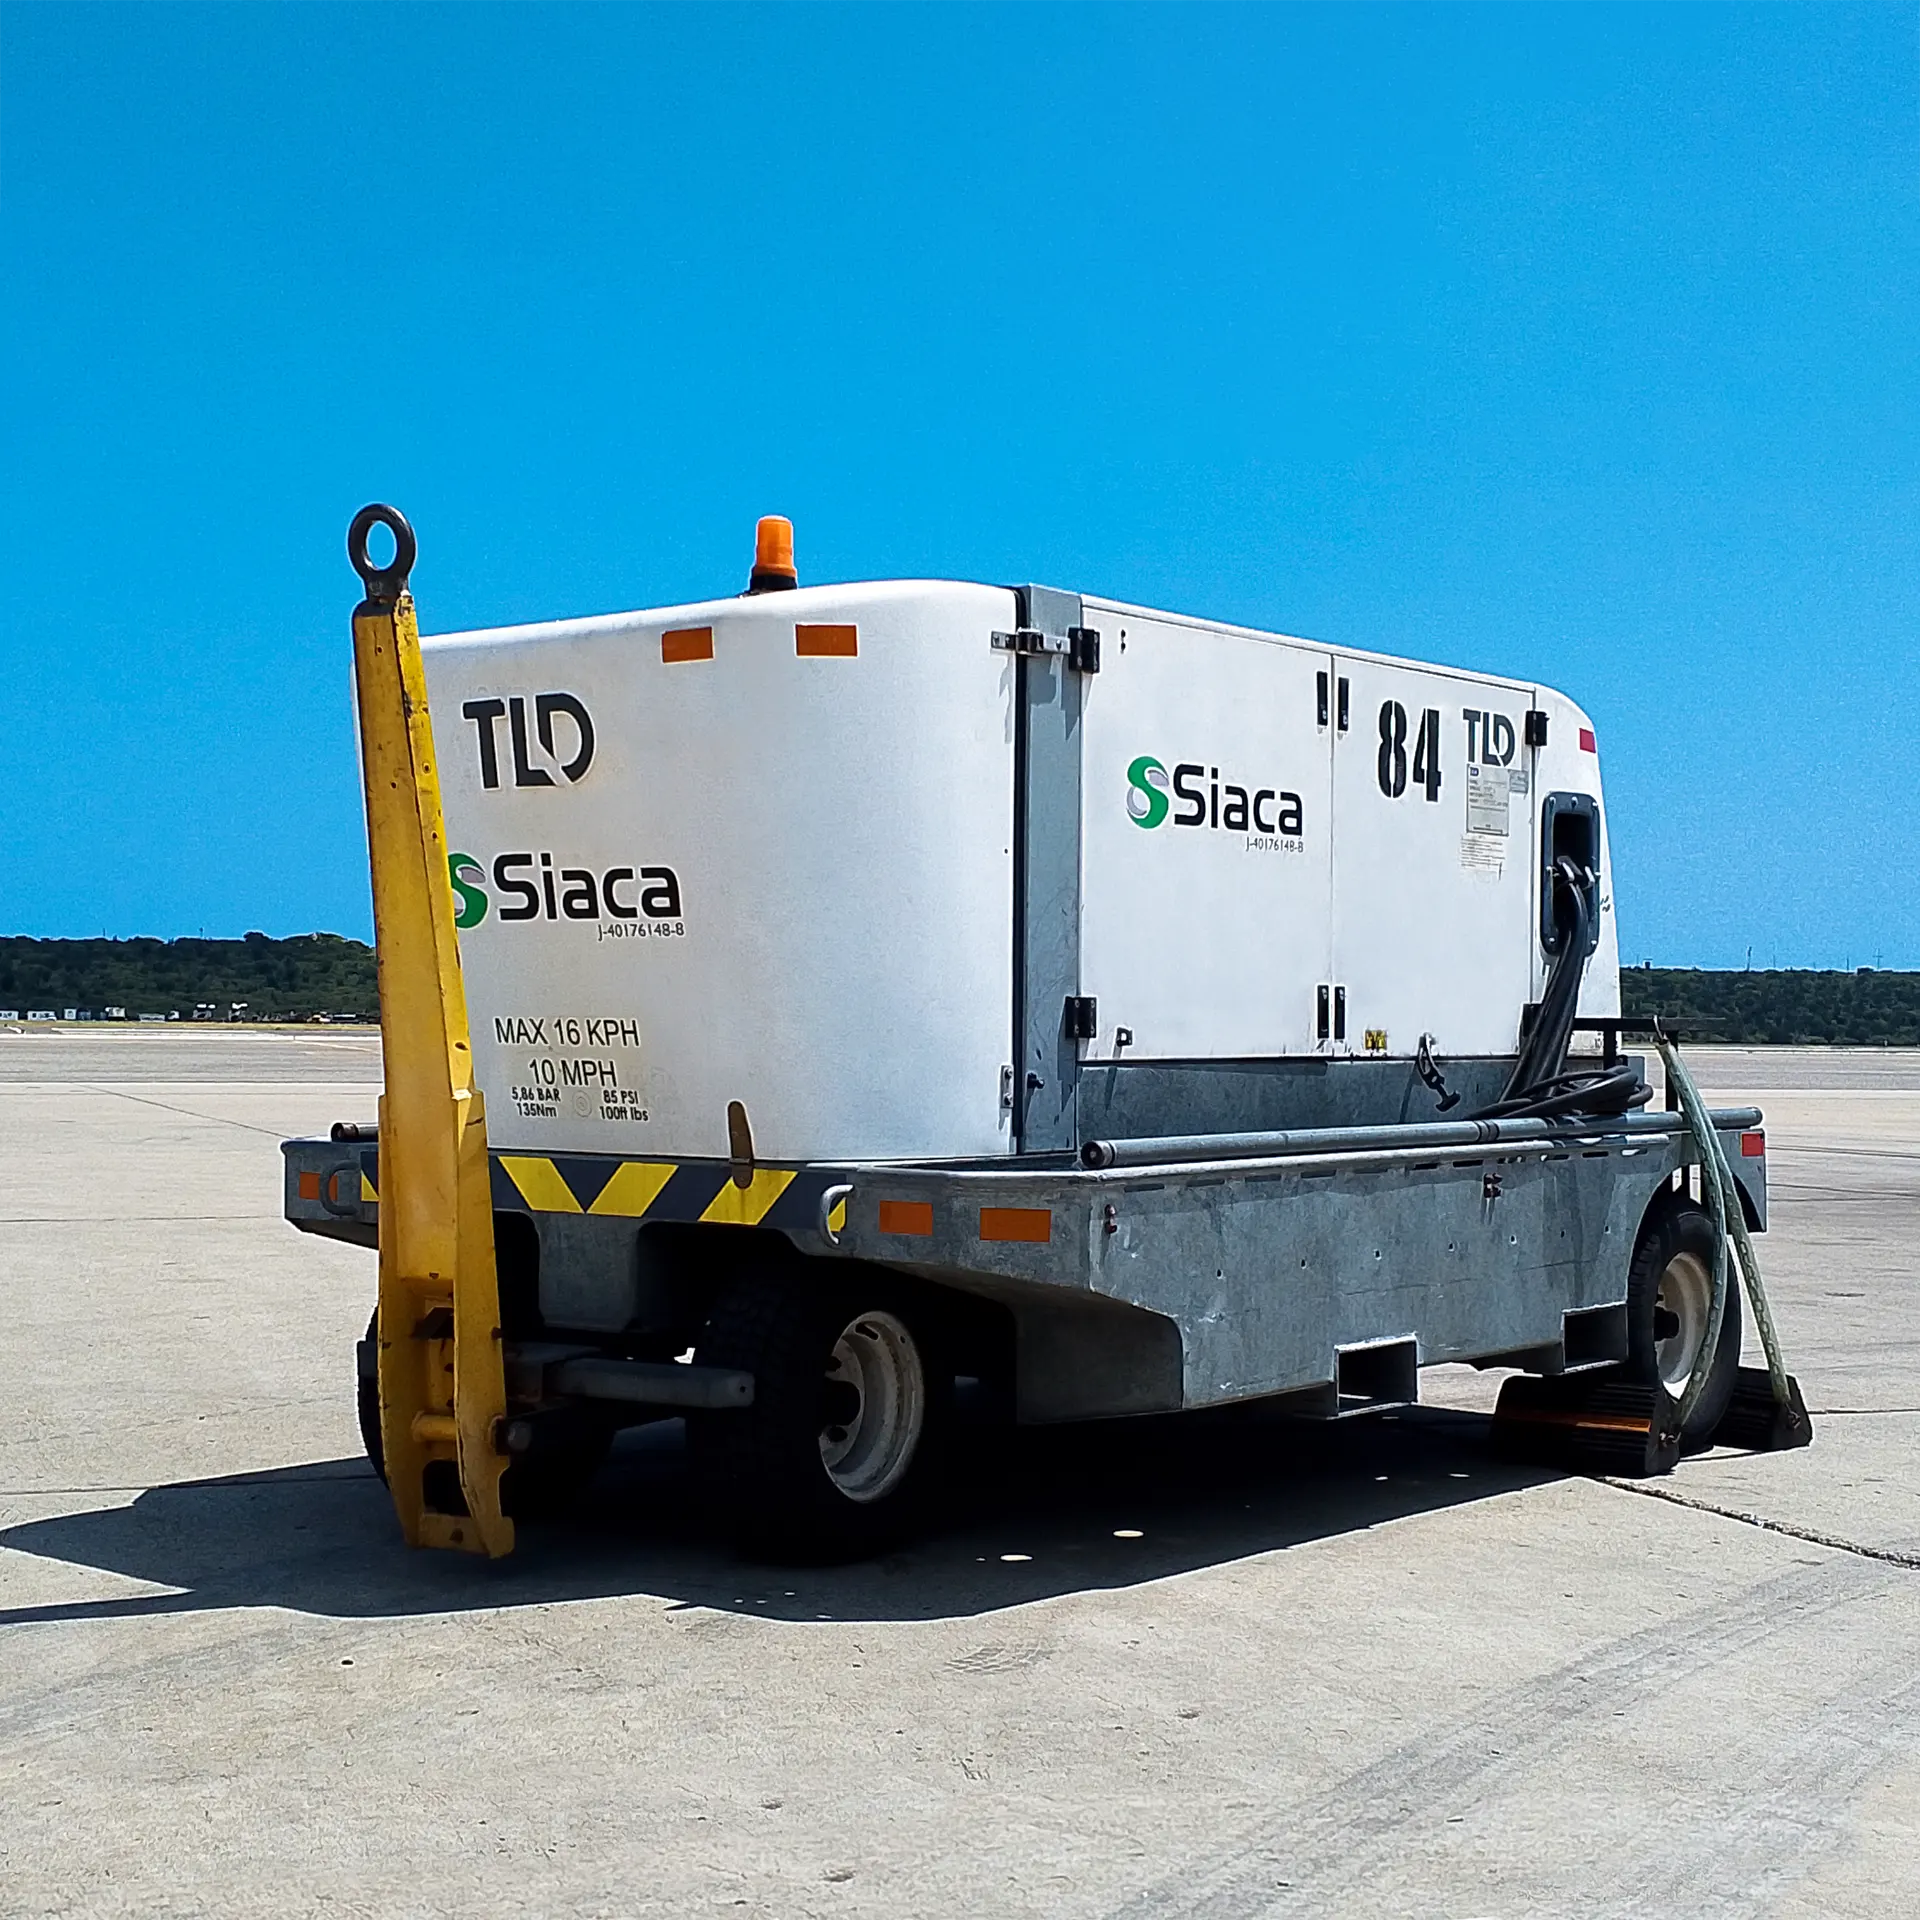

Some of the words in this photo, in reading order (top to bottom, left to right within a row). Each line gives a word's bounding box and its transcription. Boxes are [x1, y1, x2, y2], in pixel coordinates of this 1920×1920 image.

[463, 692, 595, 788] TLD
[1378, 699, 1442, 802] 84
[1463, 708, 1516, 767] TLD
[1173, 763, 1303, 836] Siaca
[493, 852, 682, 920] Siaca
[598, 922, 685, 942] J-40176148-8
[495, 1017, 548, 1044] MAX
[554, 1018, 581, 1046] 16
[586, 1019, 640, 1047] KPH
[529, 1058, 556, 1085] 10
[560, 1059, 617, 1087] MPH
[511, 1086, 534, 1102] 5,86
[536, 1087, 561, 1102] BAR
[603, 1090, 618, 1104] 85
[620, 1091, 639, 1105] PSI
[516, 1102, 557, 1117] 135Nm
[600, 1106, 628, 1121] 100ft
[630, 1106, 649, 1122] lbs
